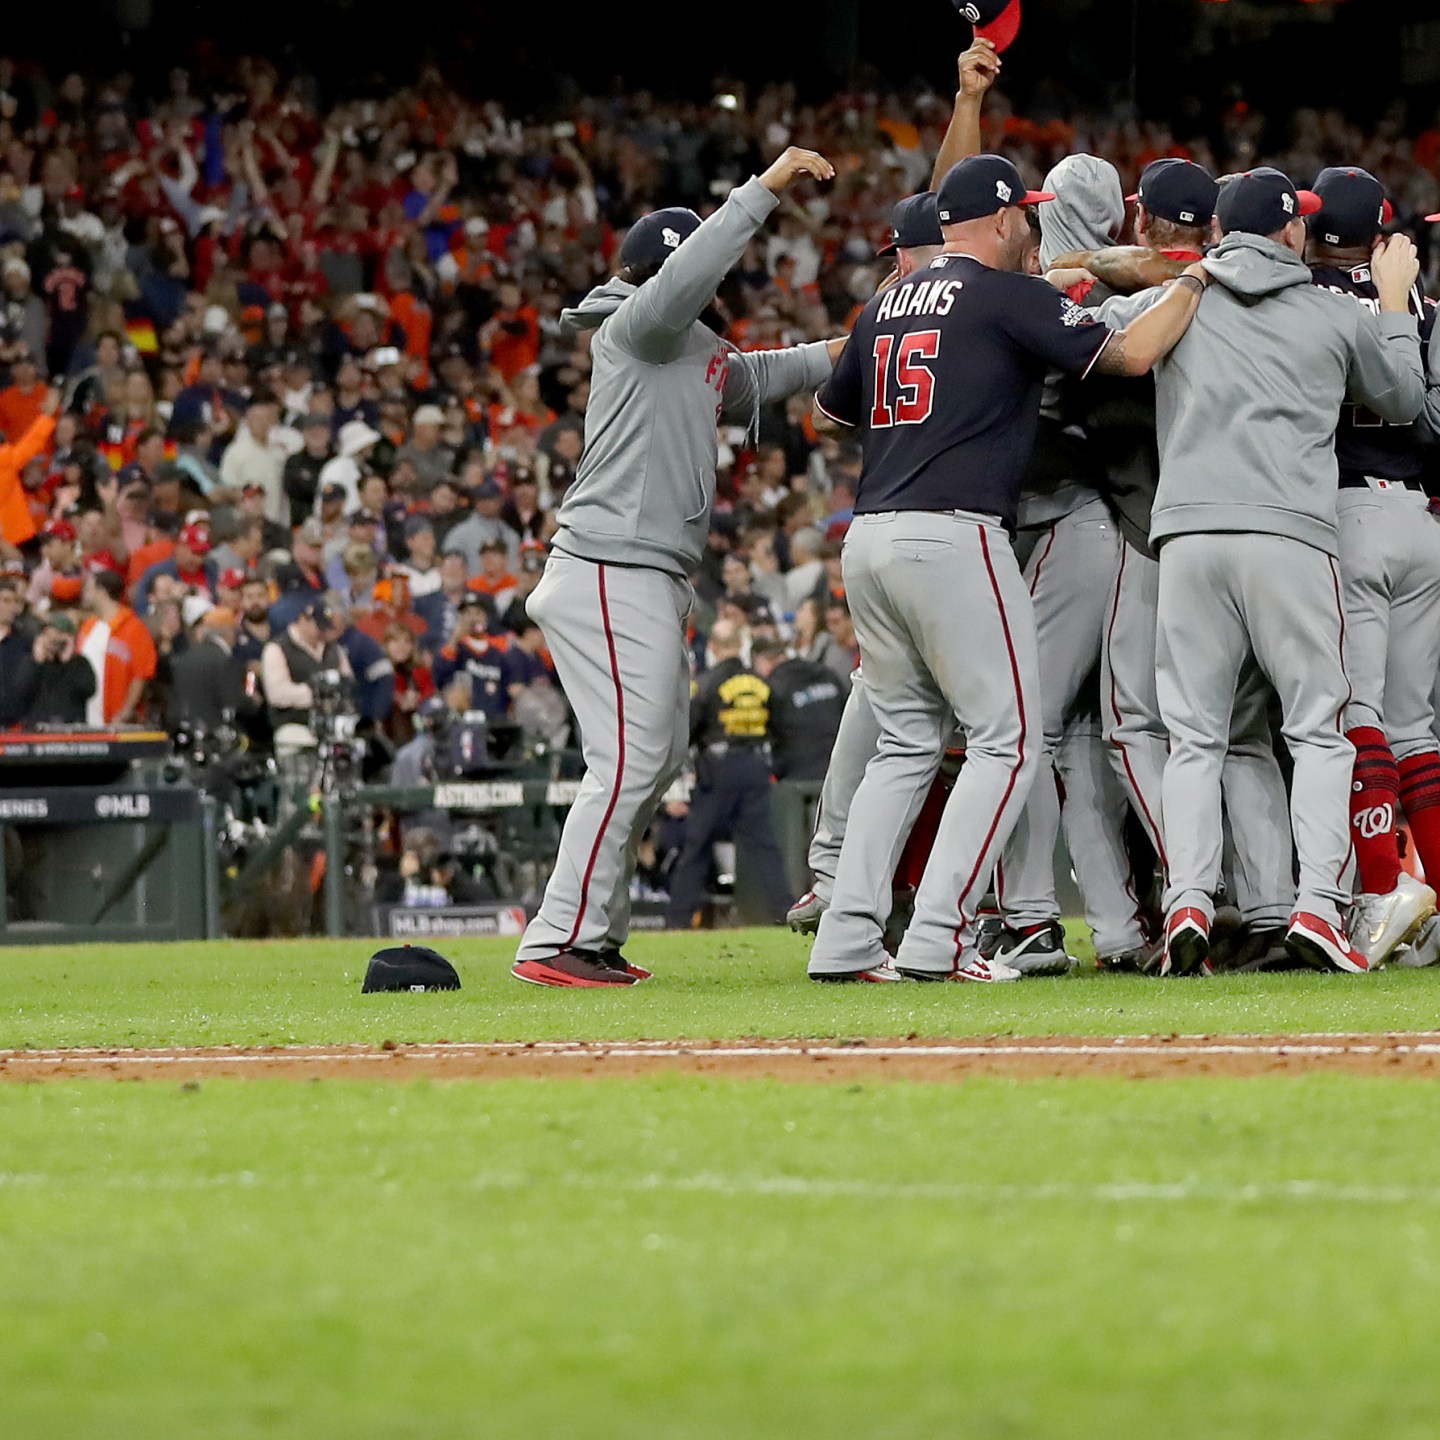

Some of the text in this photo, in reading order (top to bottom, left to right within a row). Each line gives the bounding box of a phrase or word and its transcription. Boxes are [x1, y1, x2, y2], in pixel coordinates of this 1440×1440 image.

[876, 279, 963, 323] ADAMS
[870, 329, 941, 429] 15
[0, 798, 49, 818] ERIES
